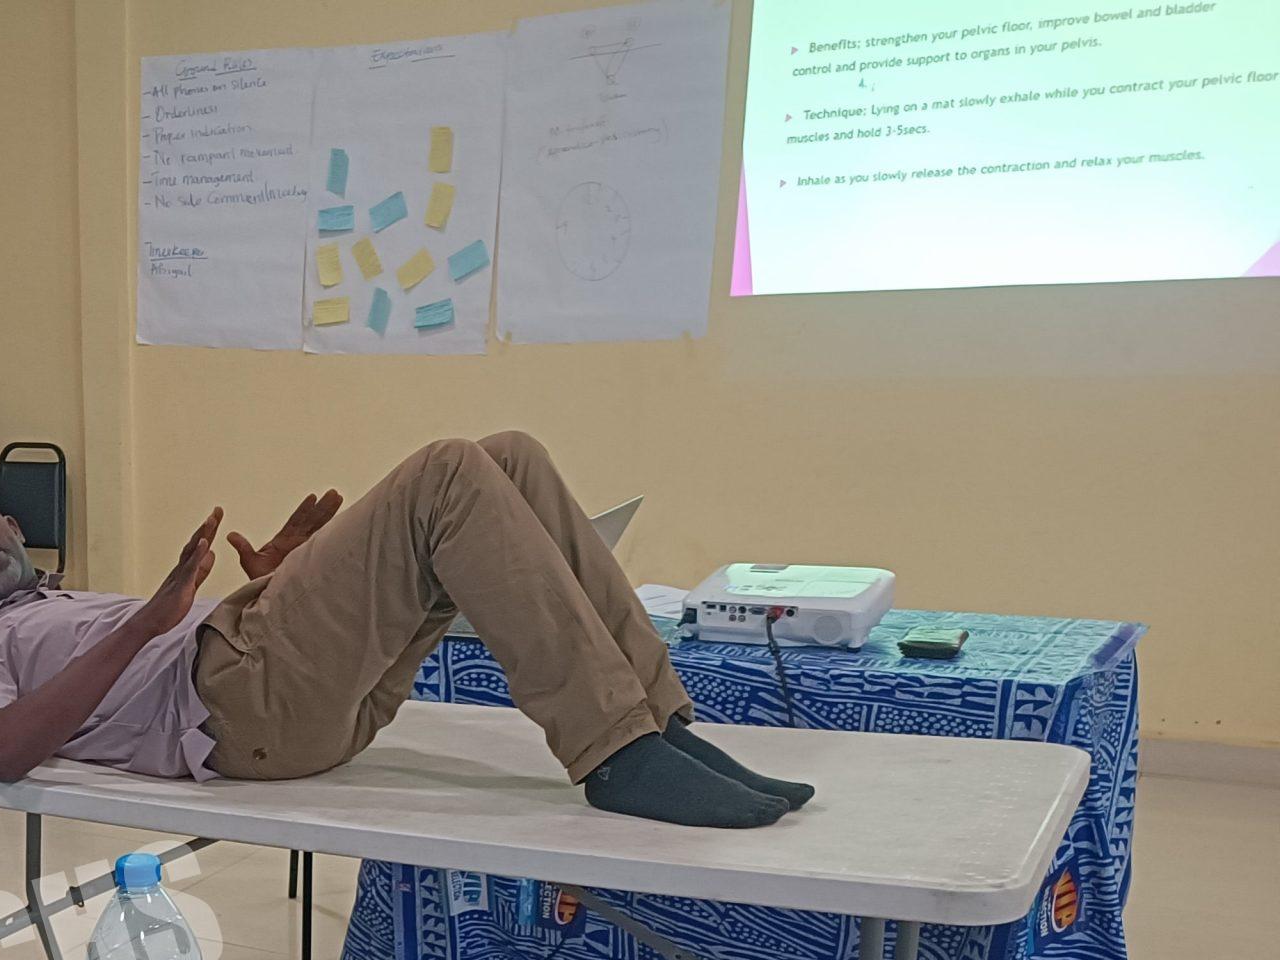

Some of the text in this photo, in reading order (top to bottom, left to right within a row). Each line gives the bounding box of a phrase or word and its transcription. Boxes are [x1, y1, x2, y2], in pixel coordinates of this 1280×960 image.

[865, 32, 927, 47] strengthen
[931, 30, 958, 43] your
[961, 25, 997, 39] pelvic
[1002, 20, 1033, 32] floor,
[1038, 14, 1090, 30] improve
[1094, 9, 1132, 23] bowel
[1137, 5, 1161, 19] and
[1166, 1, 1216, 16] bladder
[792, 36, 1102, 77] control and provide support to organs in your pelvis.
[803, 70, 1279, 121] Technique: Lying on a mat slowly exhale while you contract your pelvic floor
[786, 124, 931, 144] muscles and hold 3-5secs.
[797, 150, 1205, 187] Inhale as you slowly release the contraction and relax your muscles.
